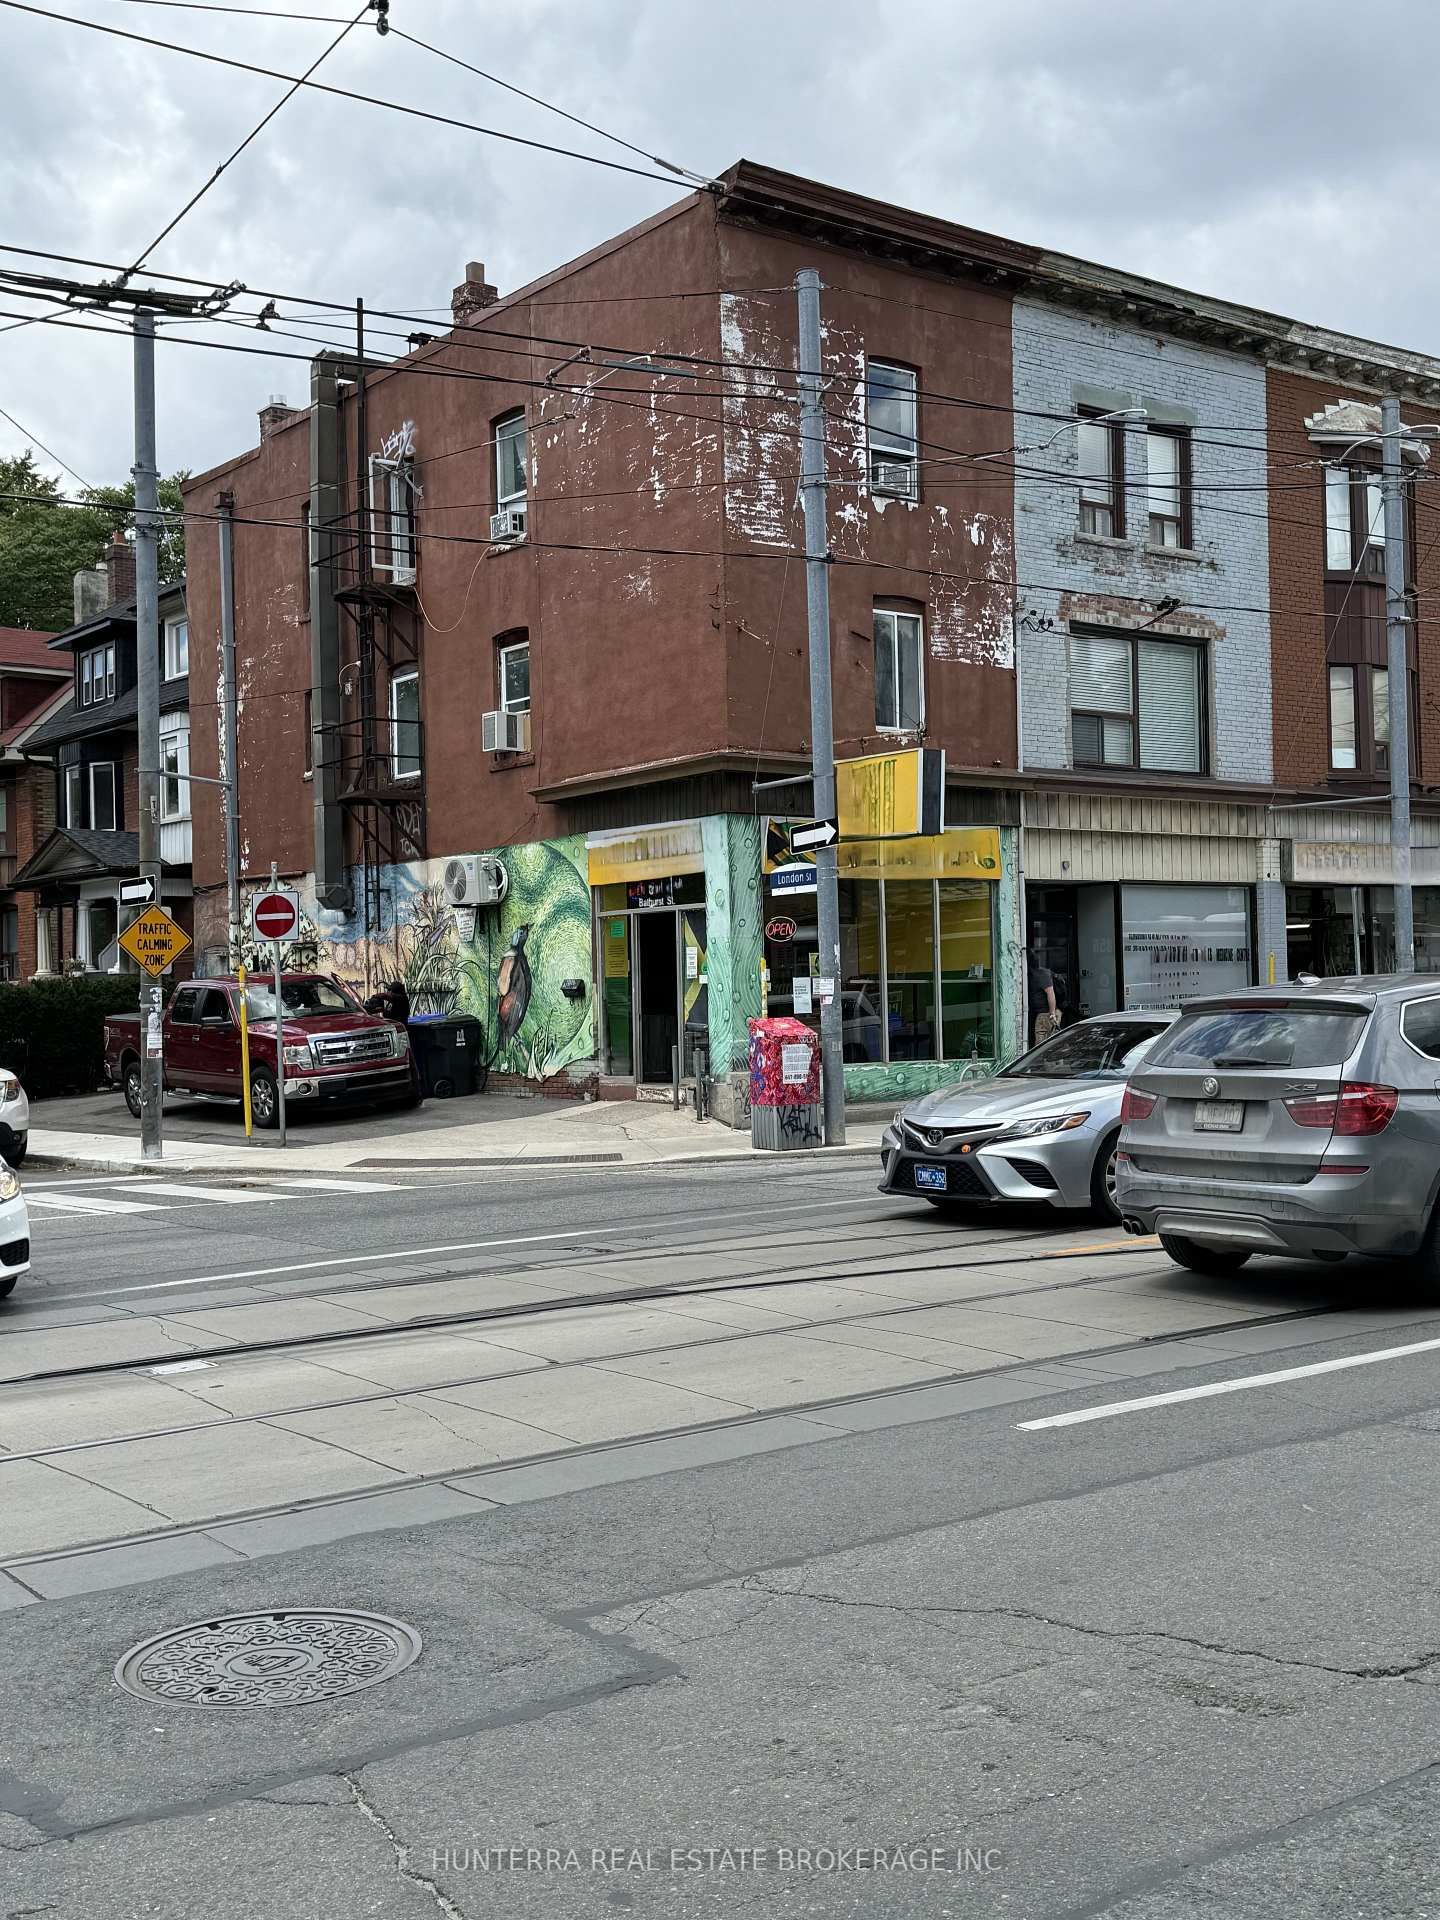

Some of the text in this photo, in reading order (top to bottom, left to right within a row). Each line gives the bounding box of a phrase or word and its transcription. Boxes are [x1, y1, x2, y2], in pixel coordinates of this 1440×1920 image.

[777, 873, 804, 885] London
[638, 896, 665, 908] Bathurst
[137, 922, 172, 935] TRAFFIC
[767, 922, 794, 936] OPEN
[137, 938, 173, 951] CALMING
[144, 954, 166, 966] ZONE
[1281, 1083, 1318, 1092] X3
